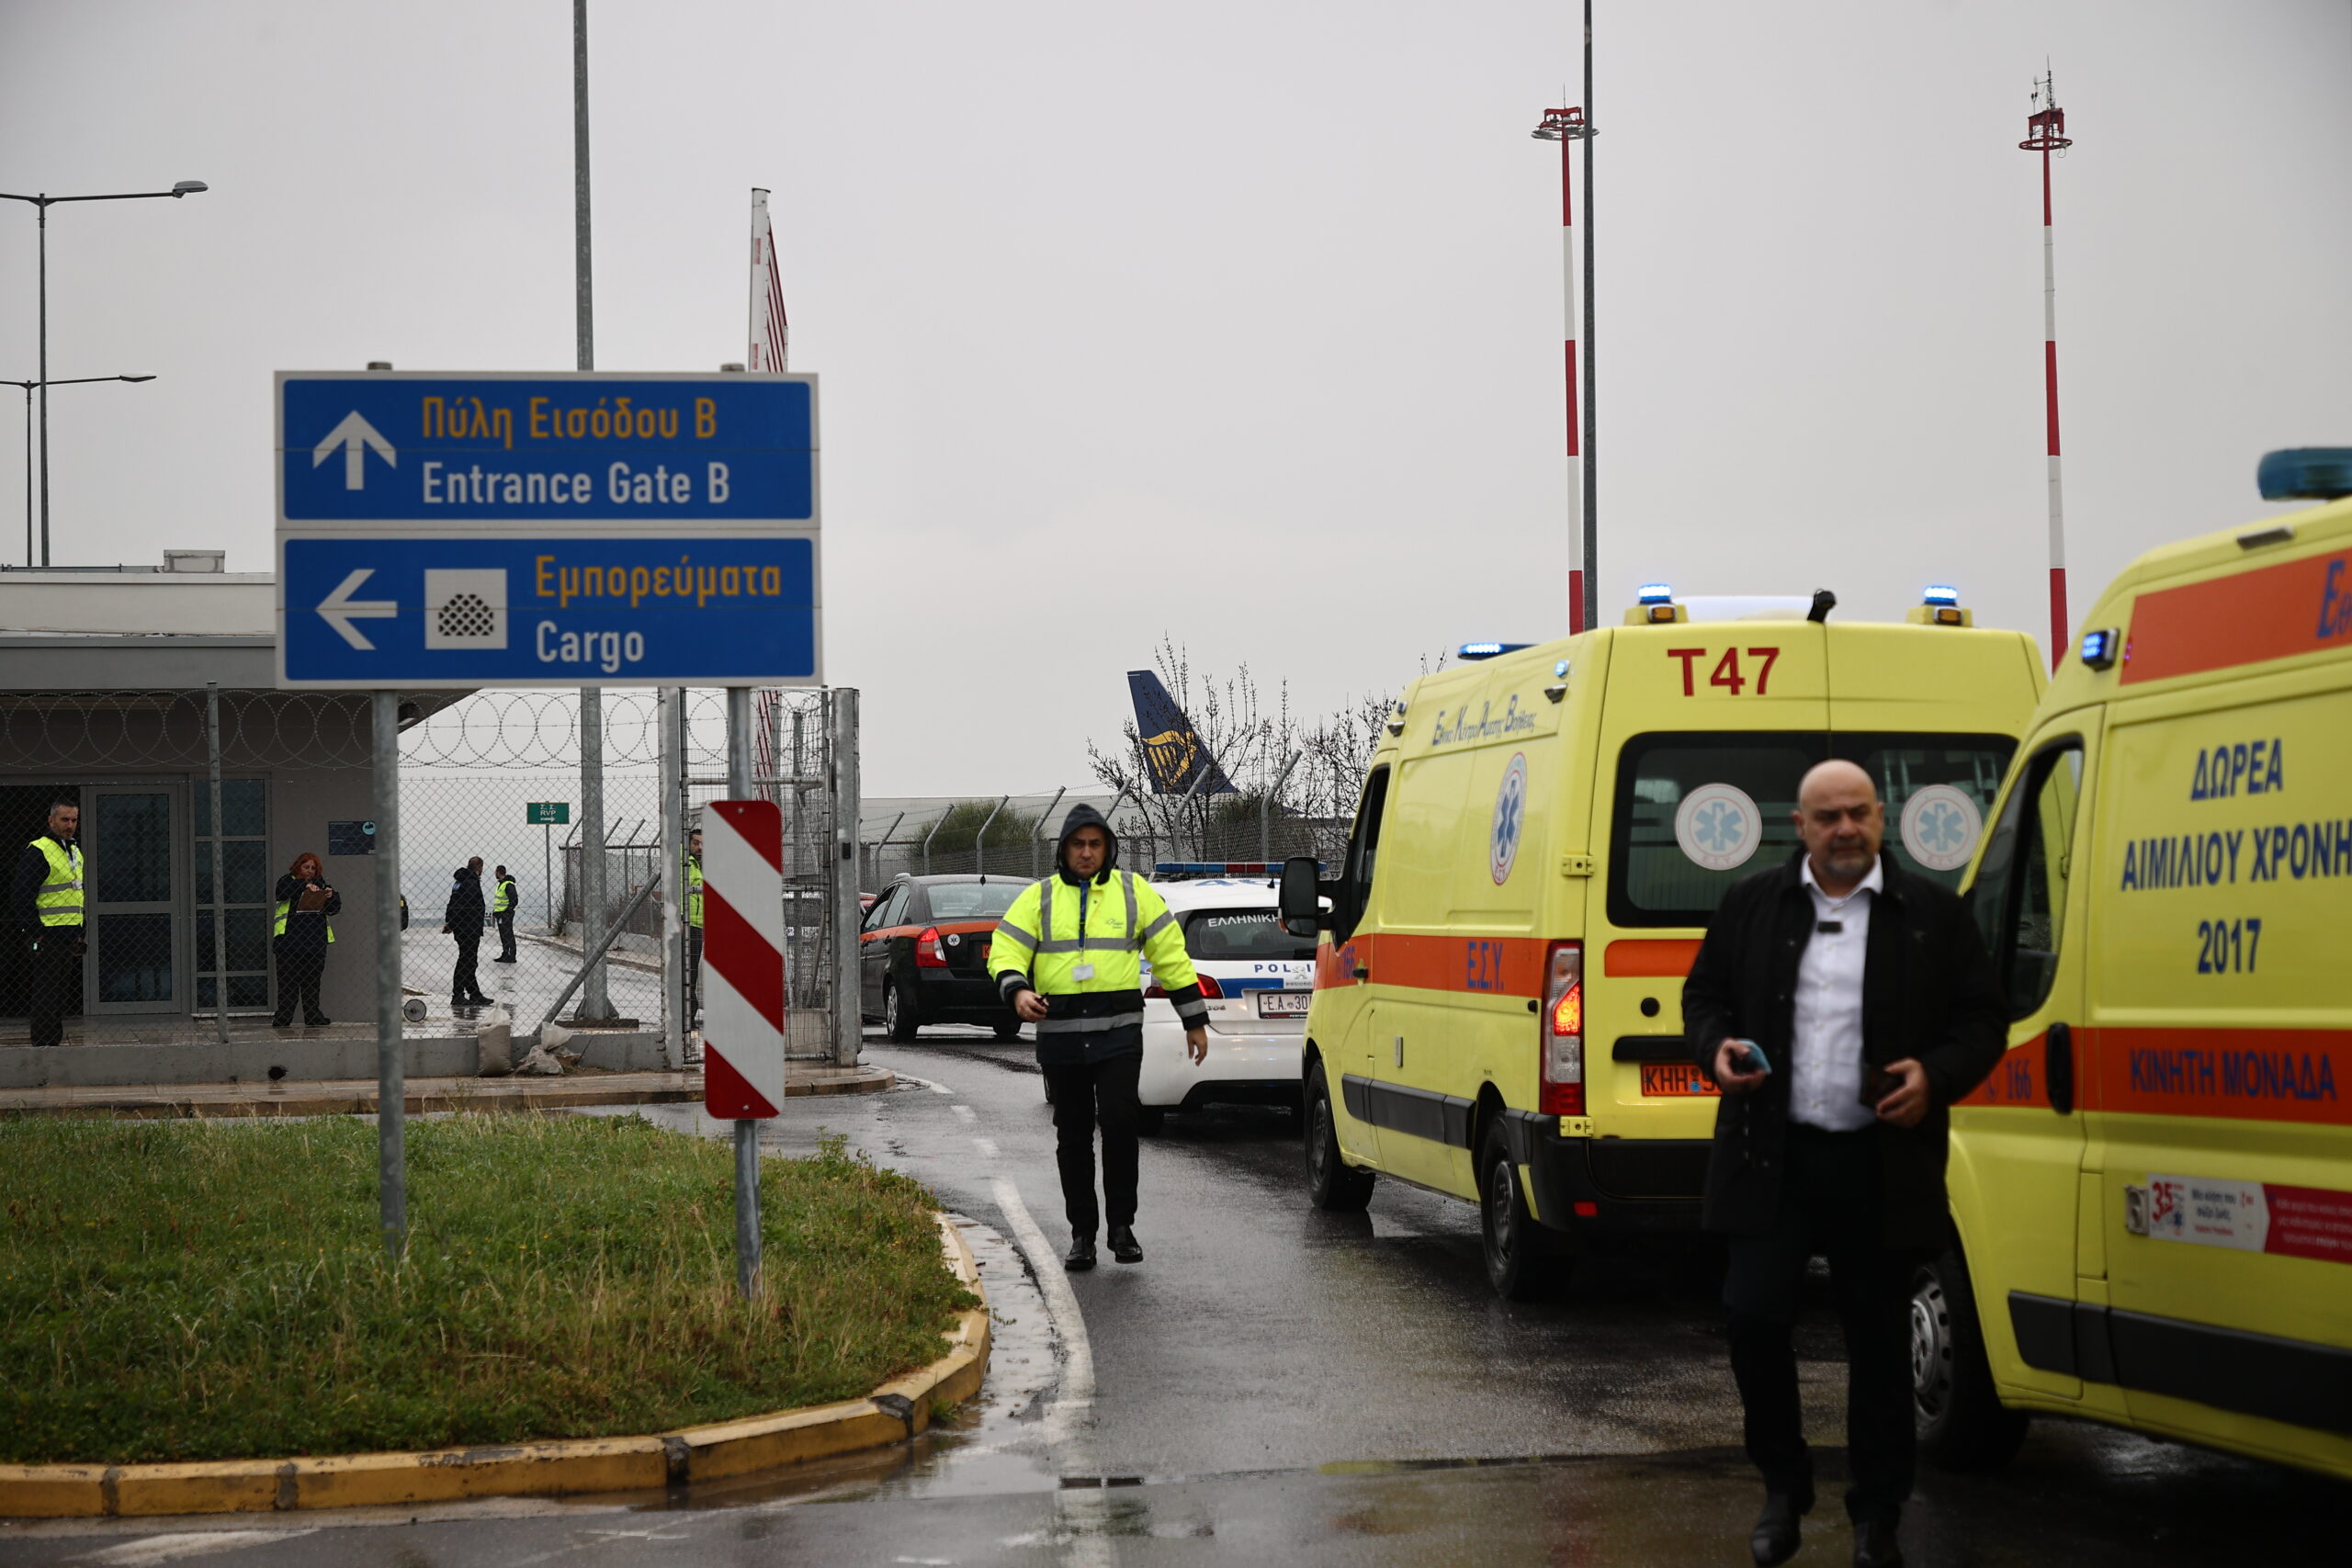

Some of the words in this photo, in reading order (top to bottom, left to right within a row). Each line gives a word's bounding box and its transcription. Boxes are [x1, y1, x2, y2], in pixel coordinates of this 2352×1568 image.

[423, 396, 513, 449] Πύλη
[529, 397, 678, 438] Εισόδου
[423, 462, 592, 503] Entrance
[608, 462, 691, 503] Gate
[708, 462, 730, 503] B
[536, 555, 781, 608] Εμπορεύματα
[536, 620, 644, 673] Cargo
[1667, 647, 1781, 697] T47
[2190, 738, 2284, 802] ΔΩΡΕΑ
[2120, 829, 2245, 892] ΑΙΜΙΛΙΟΥ
[2196, 918, 2262, 975] 2017
[2006, 1058, 2032, 1100] 166
[2130, 1049, 2215, 1095] ΚΙΝΗΤΗ
[2221, 1051, 2337, 1100] ΜΟΝΑΔΑ
